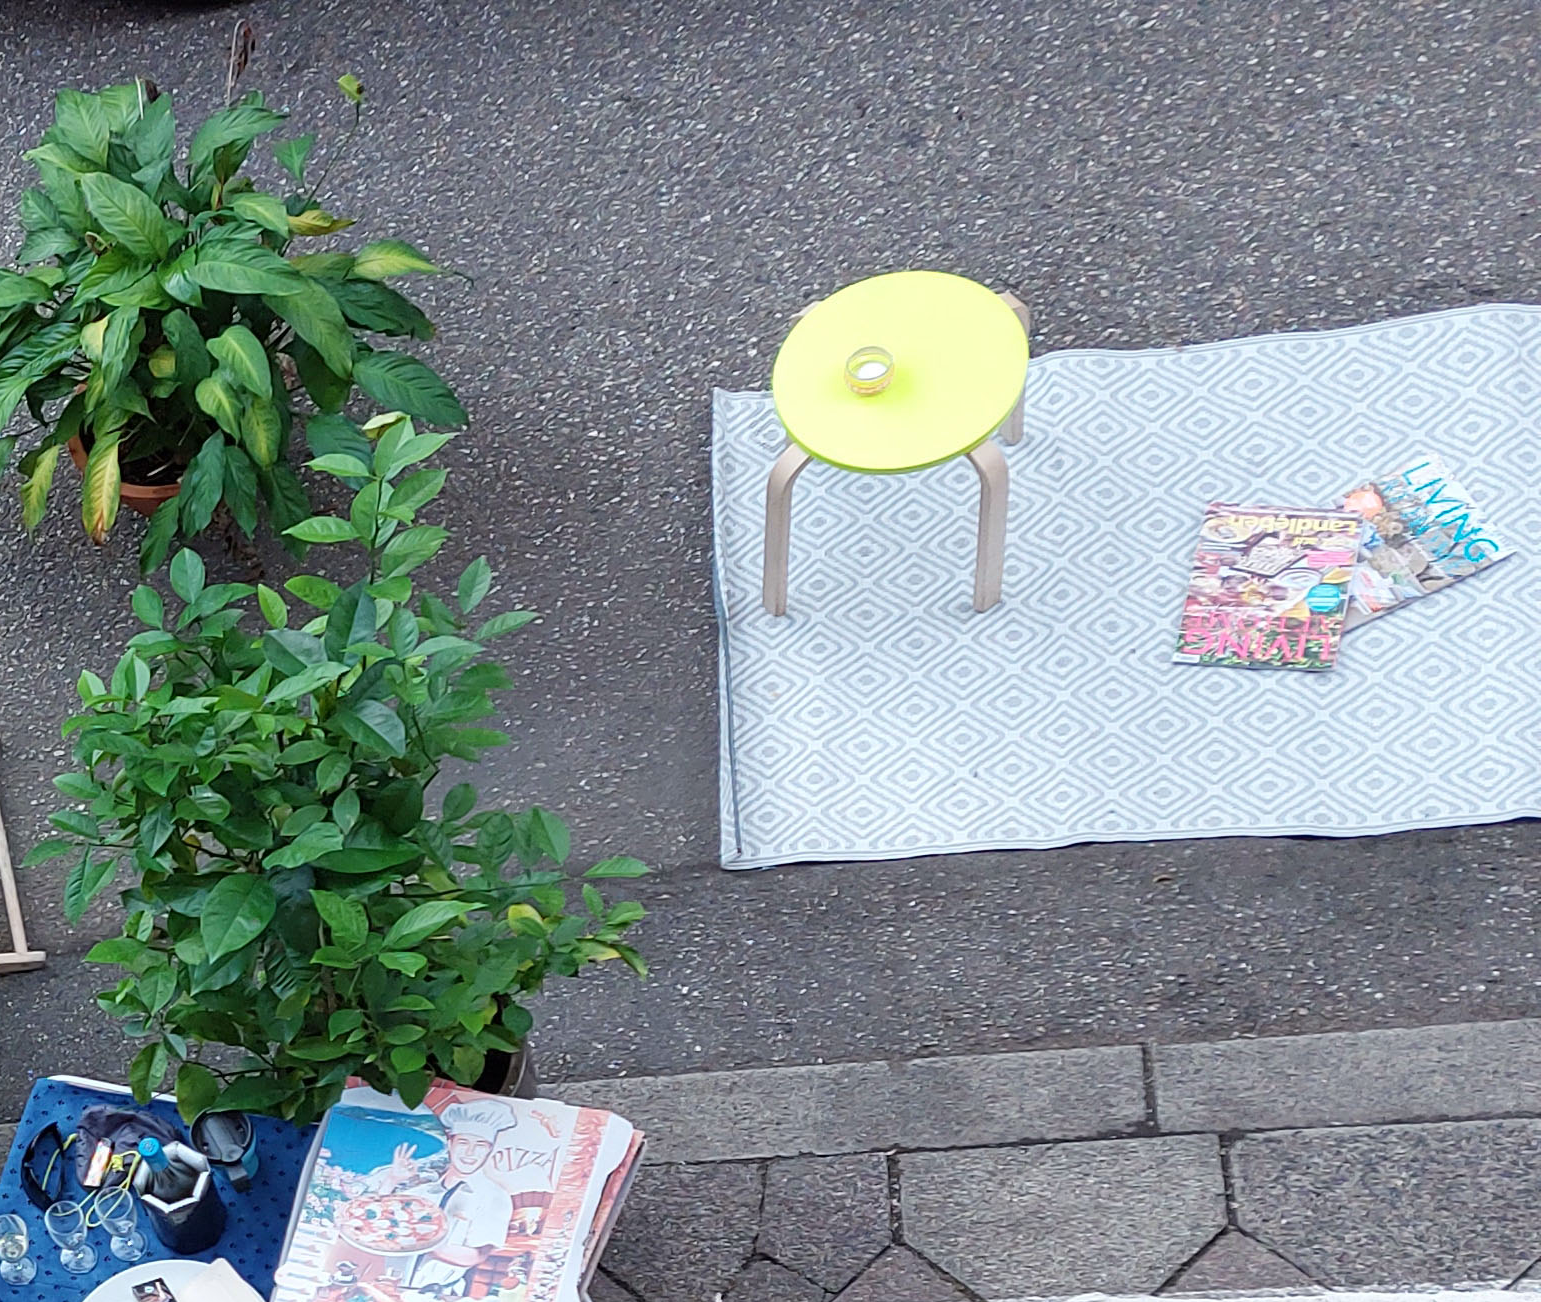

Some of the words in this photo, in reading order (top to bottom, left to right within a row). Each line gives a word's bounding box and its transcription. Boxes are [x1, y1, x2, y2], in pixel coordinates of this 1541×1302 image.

[1402, 462, 1499, 562] LIVING
[1181, 628, 1332, 662] LIVING
[493, 1145, 561, 1189] PIZZA
